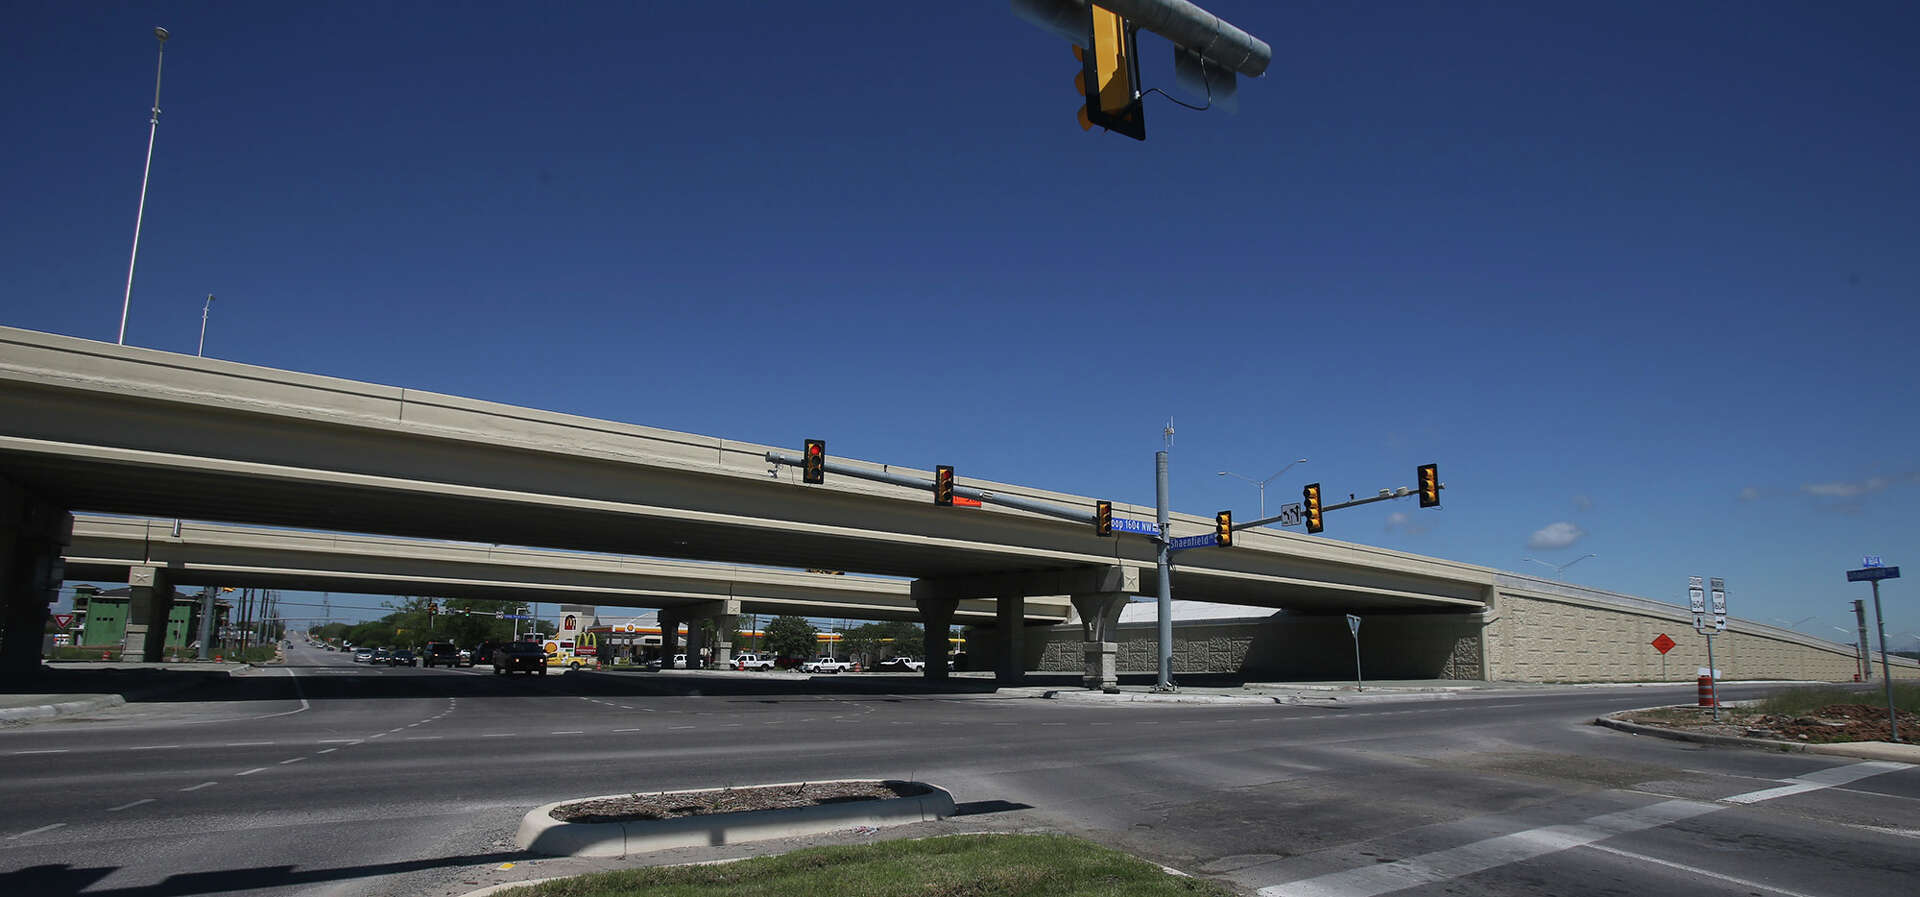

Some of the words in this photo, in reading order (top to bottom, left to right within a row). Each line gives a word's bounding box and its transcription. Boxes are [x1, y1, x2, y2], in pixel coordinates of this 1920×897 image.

[1125, 520, 1140, 531] 1604
[1142, 522, 1152, 532] NW
[1170, 536, 1209, 549] Shaenfield
